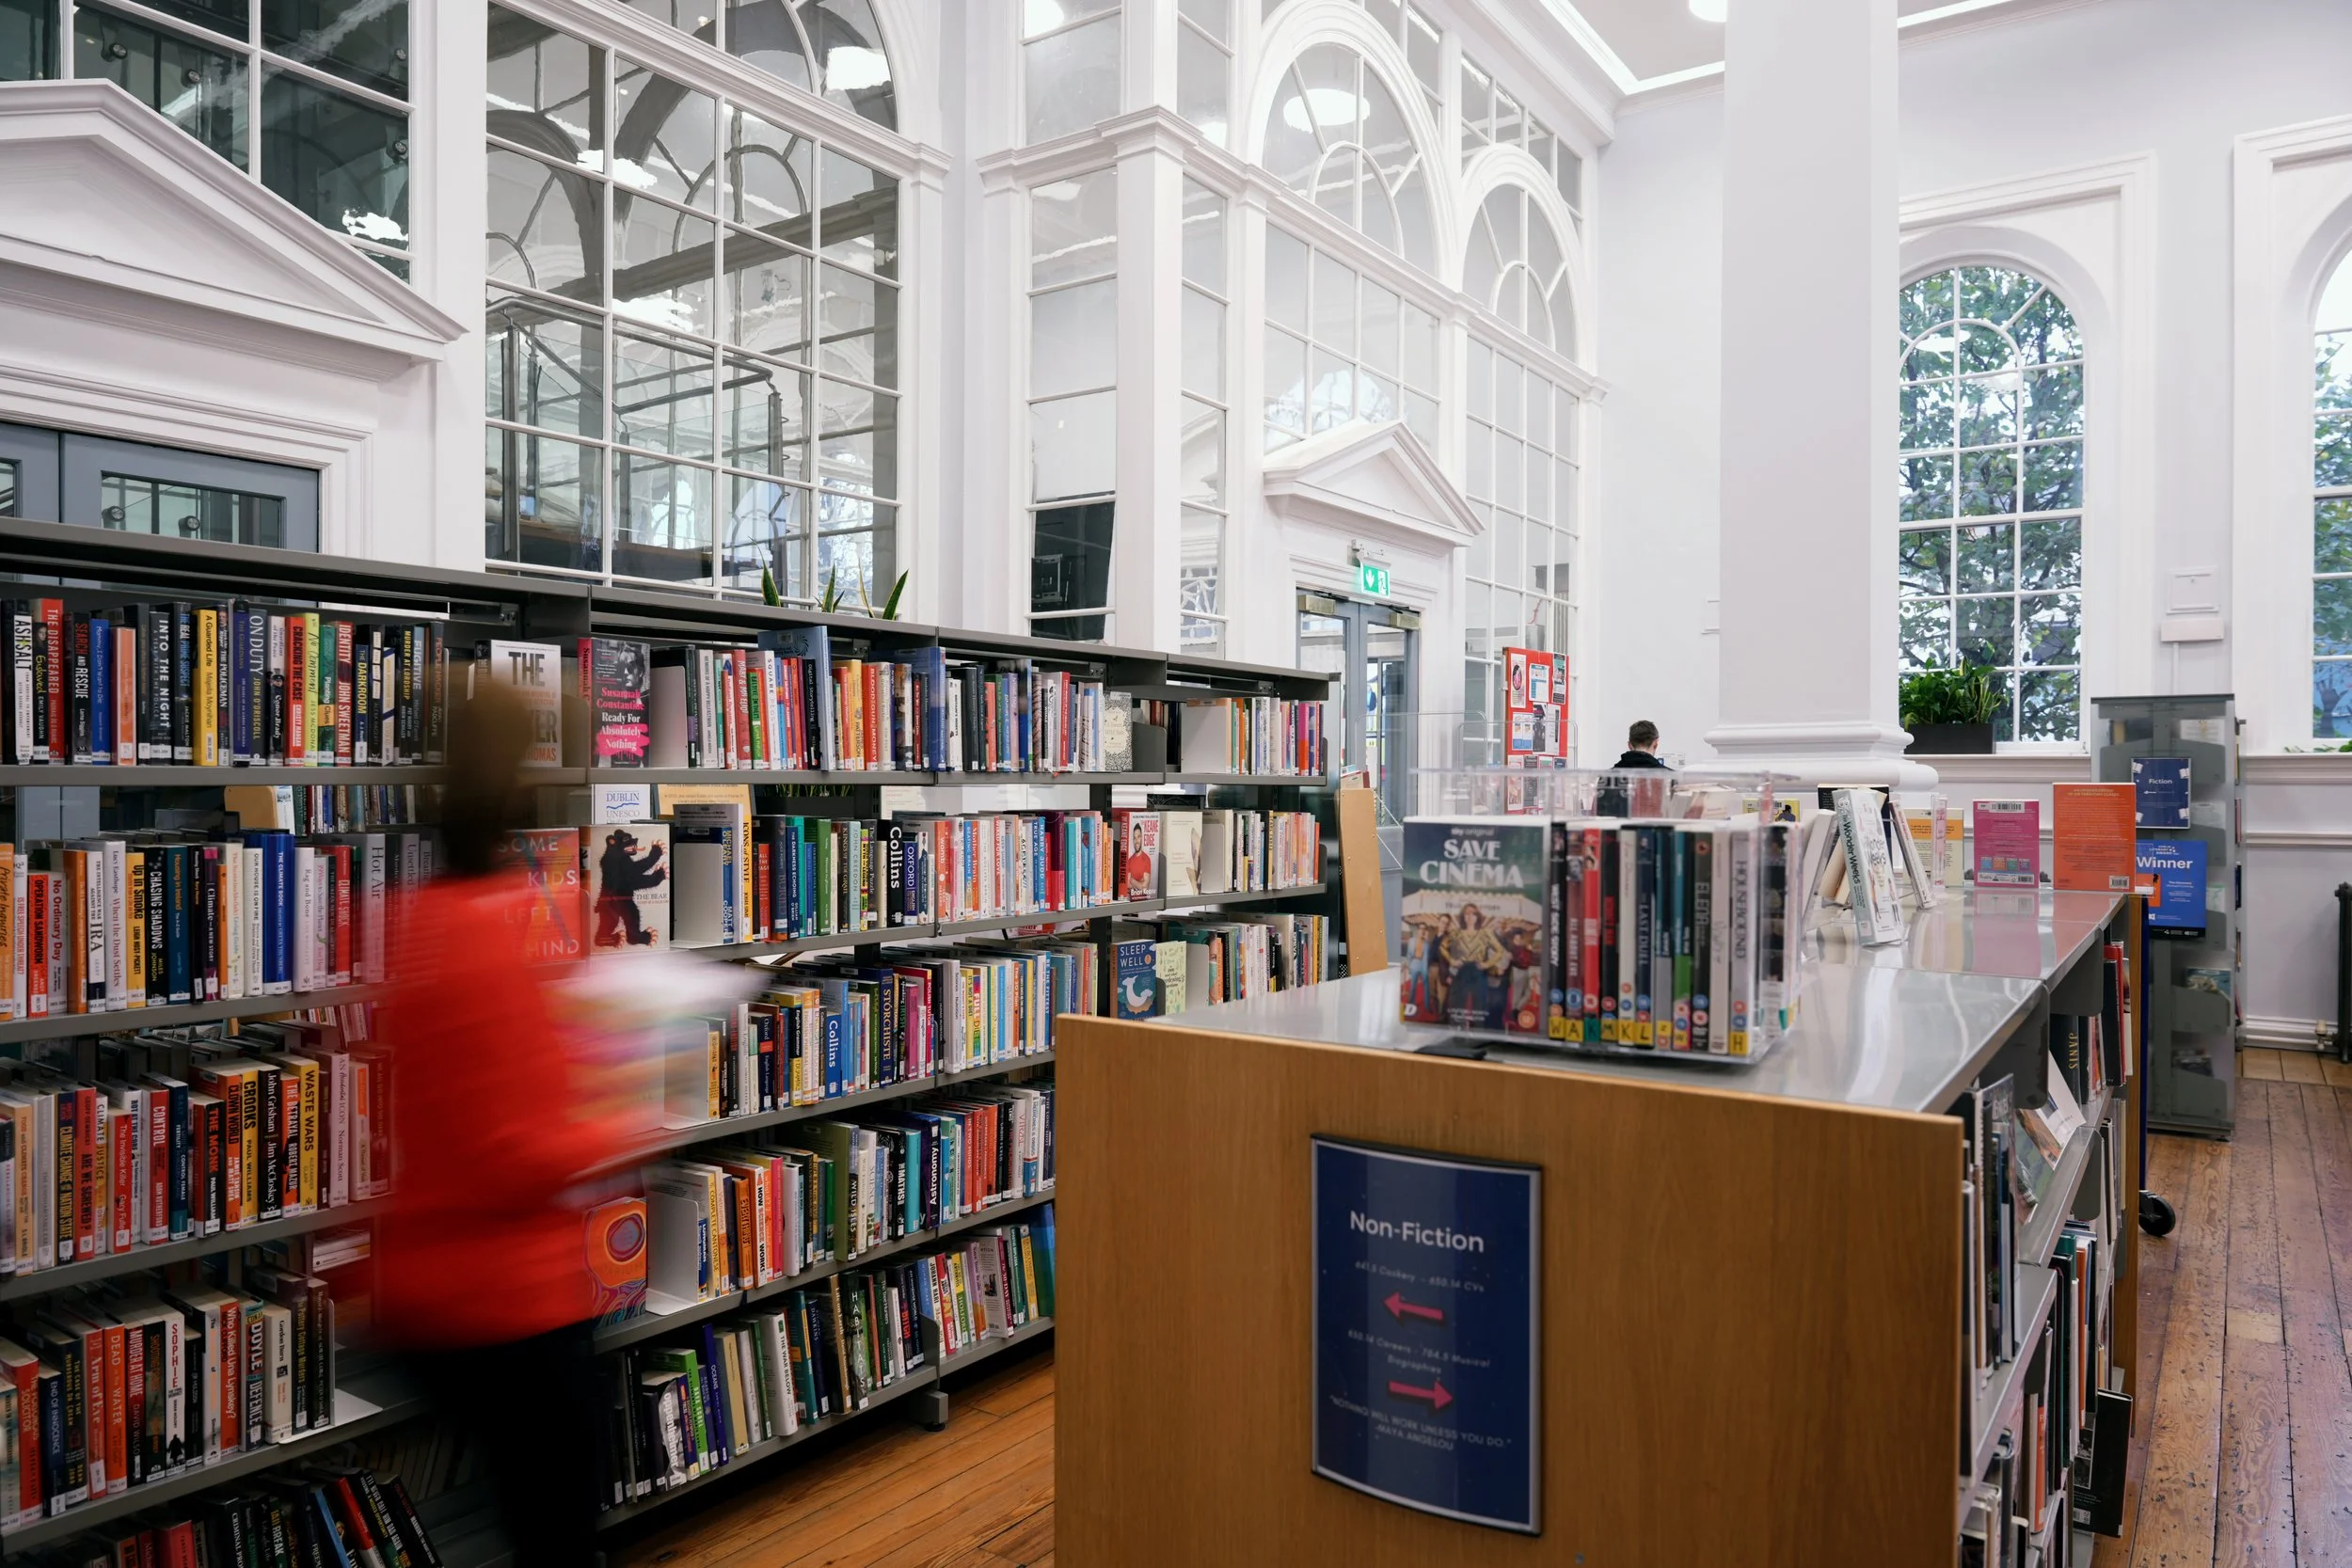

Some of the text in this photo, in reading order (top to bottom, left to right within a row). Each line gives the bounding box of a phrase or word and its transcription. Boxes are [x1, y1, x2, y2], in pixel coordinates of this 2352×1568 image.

[48, 610, 58, 693] THE DISAPPEARED
[75, 624, 88, 698] SEARCH AND RESCUE
[250, 616, 263, 675] ON DUTY
[293, 626, 302, 700] CRACKING THE CASE
[159, 620, 169, 727] INTO THE NIGHT
[339, 625, 350, 752] IDENTITY JOHN SWEETMAN
[358, 662, 367, 713] DARKROOM
[508, 652, 545, 686] THE
[323, 677, 331, 704] Planting
[596, 699, 644, 710] Constantine
[602, 688, 641, 698] Susannah
[600, 725, 641, 737] Absolutely
[602, 712, 641, 724] Ready For
[606, 738, 637, 752] Nothing
[606, 793, 639, 801] DUBLIN
[1144, 820, 1158, 832] KEANE
[1144, 834, 1154, 847] EDGE
[406, 845, 416, 885] Unsettled
[890, 827, 902, 888] Collins
[1444, 839, 1502, 860] SAVE
[1843, 822, 1856, 855] Wonder
[1850, 856, 1861, 884] Weeks
[2137, 857, 2193, 869] Winner
[132, 865, 144, 877] Up
[372, 847, 384, 899] Hot Air
[1420, 861, 1524, 887] CINEMA
[34, 880, 43, 963] OPERATION SANDWORM
[51, 880, 62, 961] No Ordinary Day
[135, 889, 144, 919] Smoke
[151, 872, 162, 949] CHASING SHADOWS
[1695, 882, 1708, 925] ELENA
[1736, 860, 1746, 960] HOUSEBOUND
[90, 924, 103, 952] IRA
[1120, 944, 1146, 956] SLEEP
[1120, 958, 1143, 967] WELL
[829, 1021, 840, 1068] Collins
[882, 990, 892, 1060] STÓRCHISTE
[1568, 1025, 1579, 1037] A
[2069, 1032, 2077, 1069] JANIS
[153, 1106, 166, 1146] CONTROL
[229, 1085, 239, 1144] CLOWN WORLD
[244, 1082, 256, 1130] CROOKS
[268, 1096, 277, 1132] Grisham
[288, 1084, 297, 1138] THE BETRAYAL
[305, 1070, 314, 1151] WASTE WARS
[60, 1126, 72, 1183] CLIMATE CHANGE
[210, 1109, 218, 1173] THE MONK
[96, 1146, 104, 1180] JUSTICE
[265, 1142, 277, 1204] Jim McCloskey
[930, 1148, 939, 1204] Astronomy
[81, 1154, 92, 1230] ARE WE SCREWED?
[60, 1193, 72, 1239] NATION STATE
[1350, 1211, 1485, 1253] Non-Fiction
[228, 1331, 236, 1355] Killed
[851, 1291, 866, 1387] HABITATS
[901, 1311, 910, 1338] BITCH
[130, 1330, 142, 1397] MURDER AT HOME
[251, 1323, 262, 1370] DOYLE
[1387, 1354, 1441, 1374] Biographies
[1452, 1352, 1491, 1368] Musical
[113, 1388, 121, 1424] WATER
[226, 1378, 236, 1418] Lynskey?
[249, 1381, 262, 1425] DEFENCE
[662, 1392, 679, 1467] oppenheimer
[1372, 1409, 1393, 1426] WILL
[1395, 1415, 1419, 1432] WORK
[1422, 1420, 1457, 1440] UNLESS
[1461, 1430, 1484, 1445] YOU
[1407, 1431, 1454, 1451] ANGELOU
